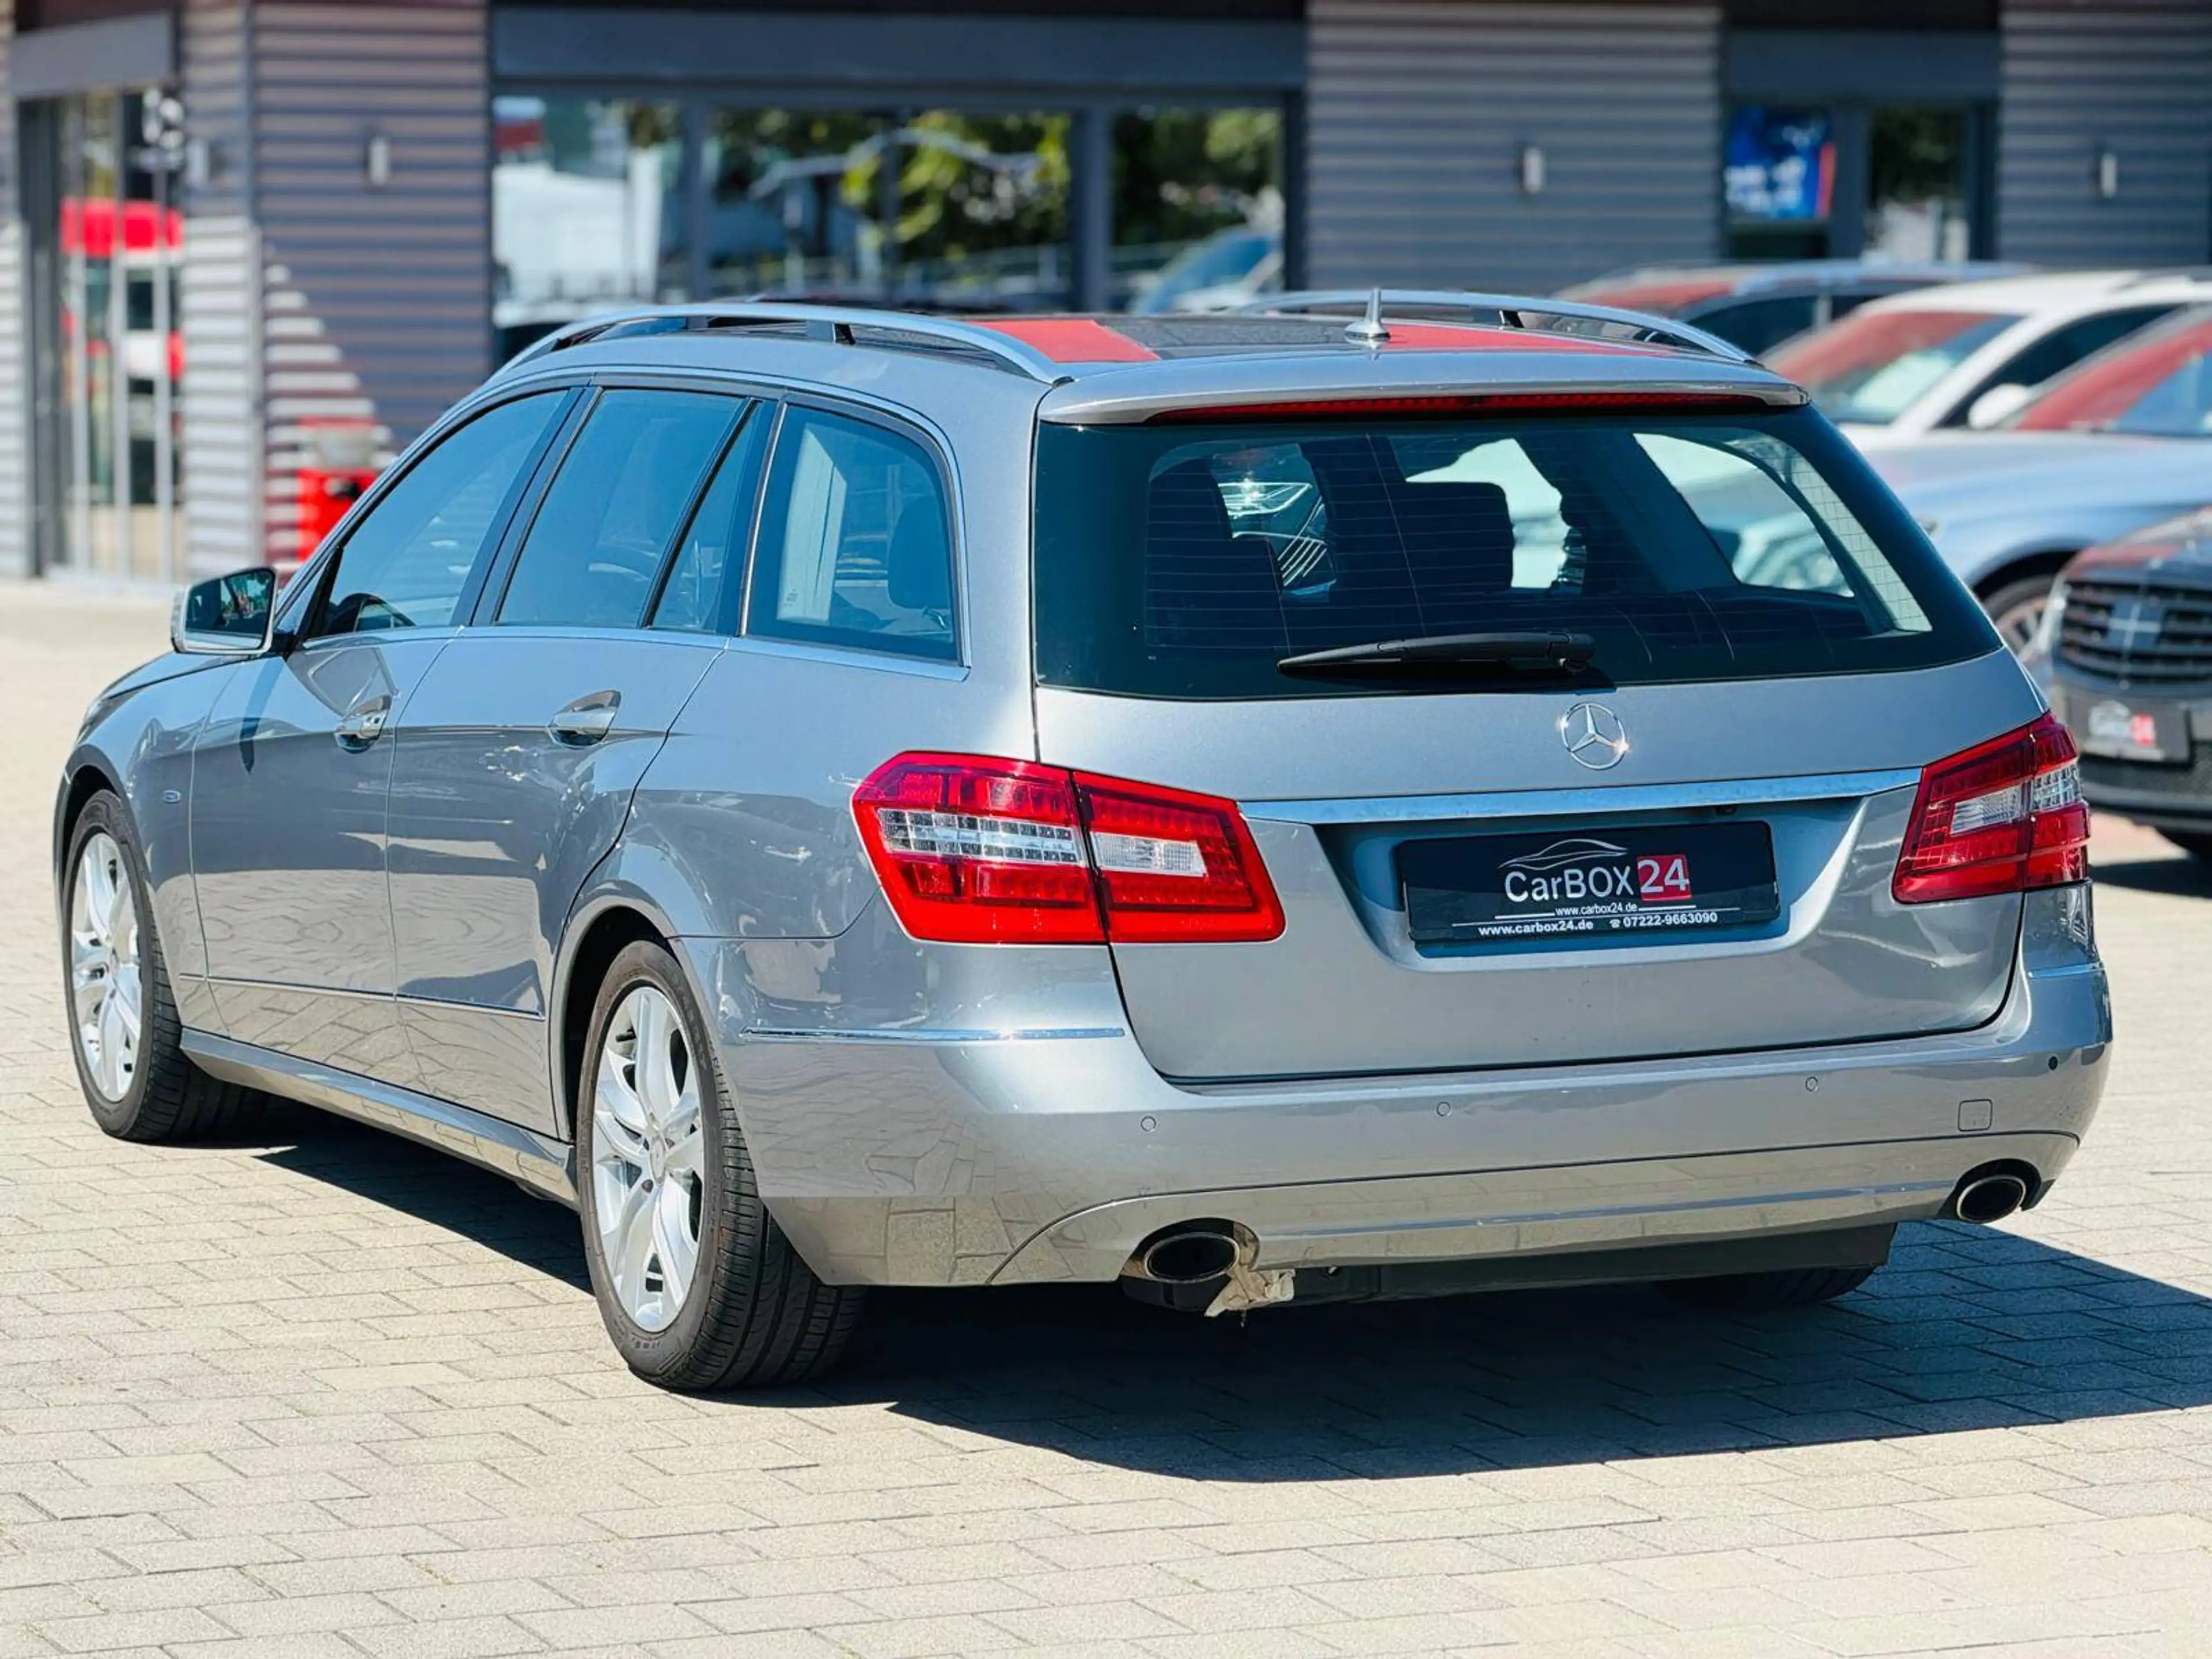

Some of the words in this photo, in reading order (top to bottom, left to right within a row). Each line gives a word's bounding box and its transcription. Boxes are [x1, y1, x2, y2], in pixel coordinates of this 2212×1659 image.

[1505, 866, 1634, 902] CarBOX
[1637, 858, 1690, 893] 24
[1556, 903, 1638, 916] www.carbox24.de
[1478, 919, 1594, 935] www.carbox24.de
[1623, 912, 1718, 928] 07222-9663090
